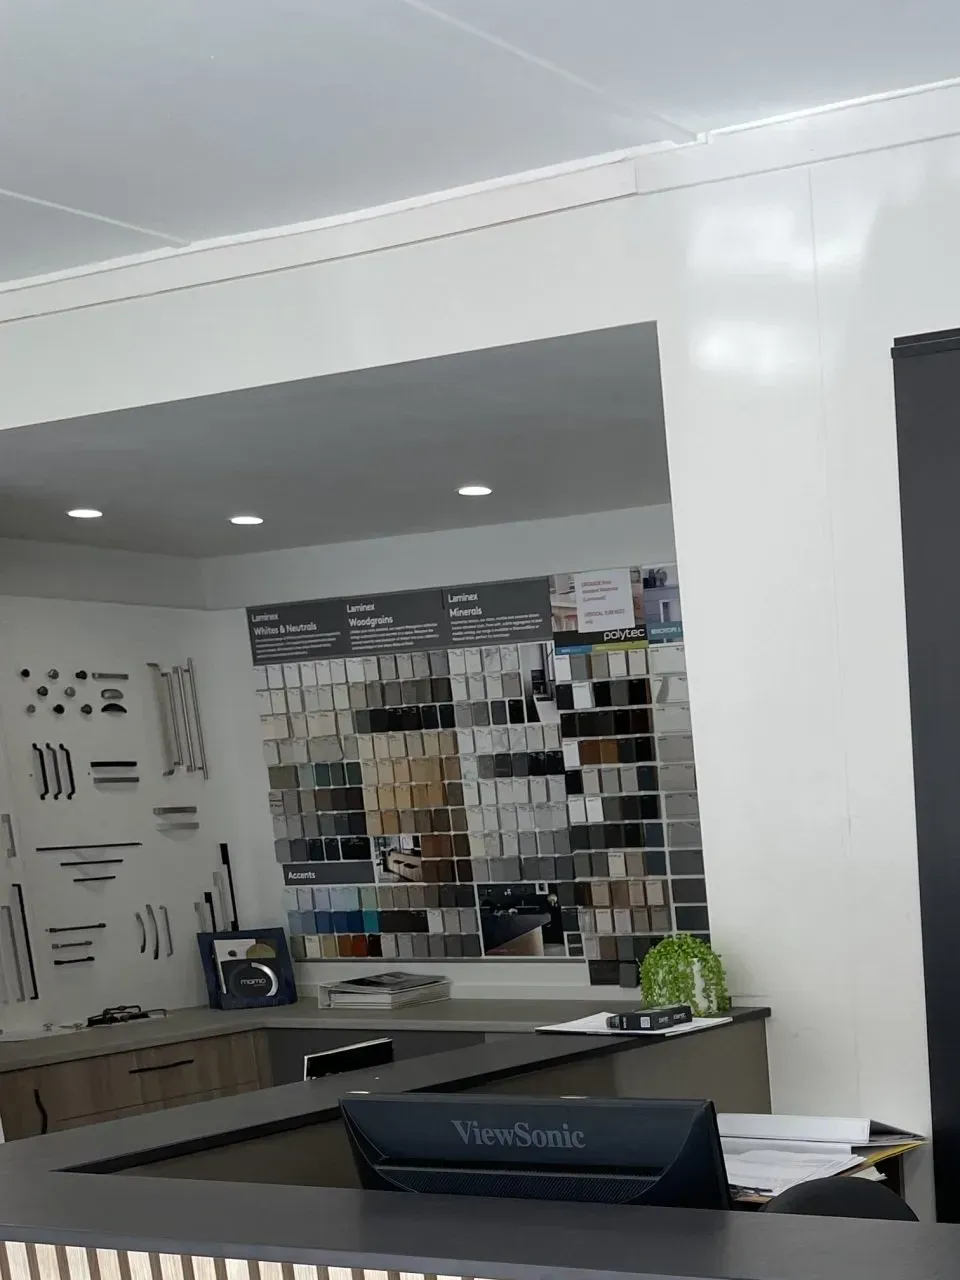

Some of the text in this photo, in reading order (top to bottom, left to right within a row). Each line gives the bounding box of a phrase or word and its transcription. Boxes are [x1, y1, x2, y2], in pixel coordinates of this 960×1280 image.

[448, 592, 478, 602] Laminex
[346, 603, 375, 612] Laminex
[450, 606, 482, 616] Minerals
[252, 612, 278, 622] Laminex
[348, 616, 394, 628] Woodgrains
[254, 622, 317, 636] Whites & Neutrals
[604, 628, 646, 642] polytec
[288, 872, 316, 880] Accents
[451, 1119, 587, 1151] ViewSonic
